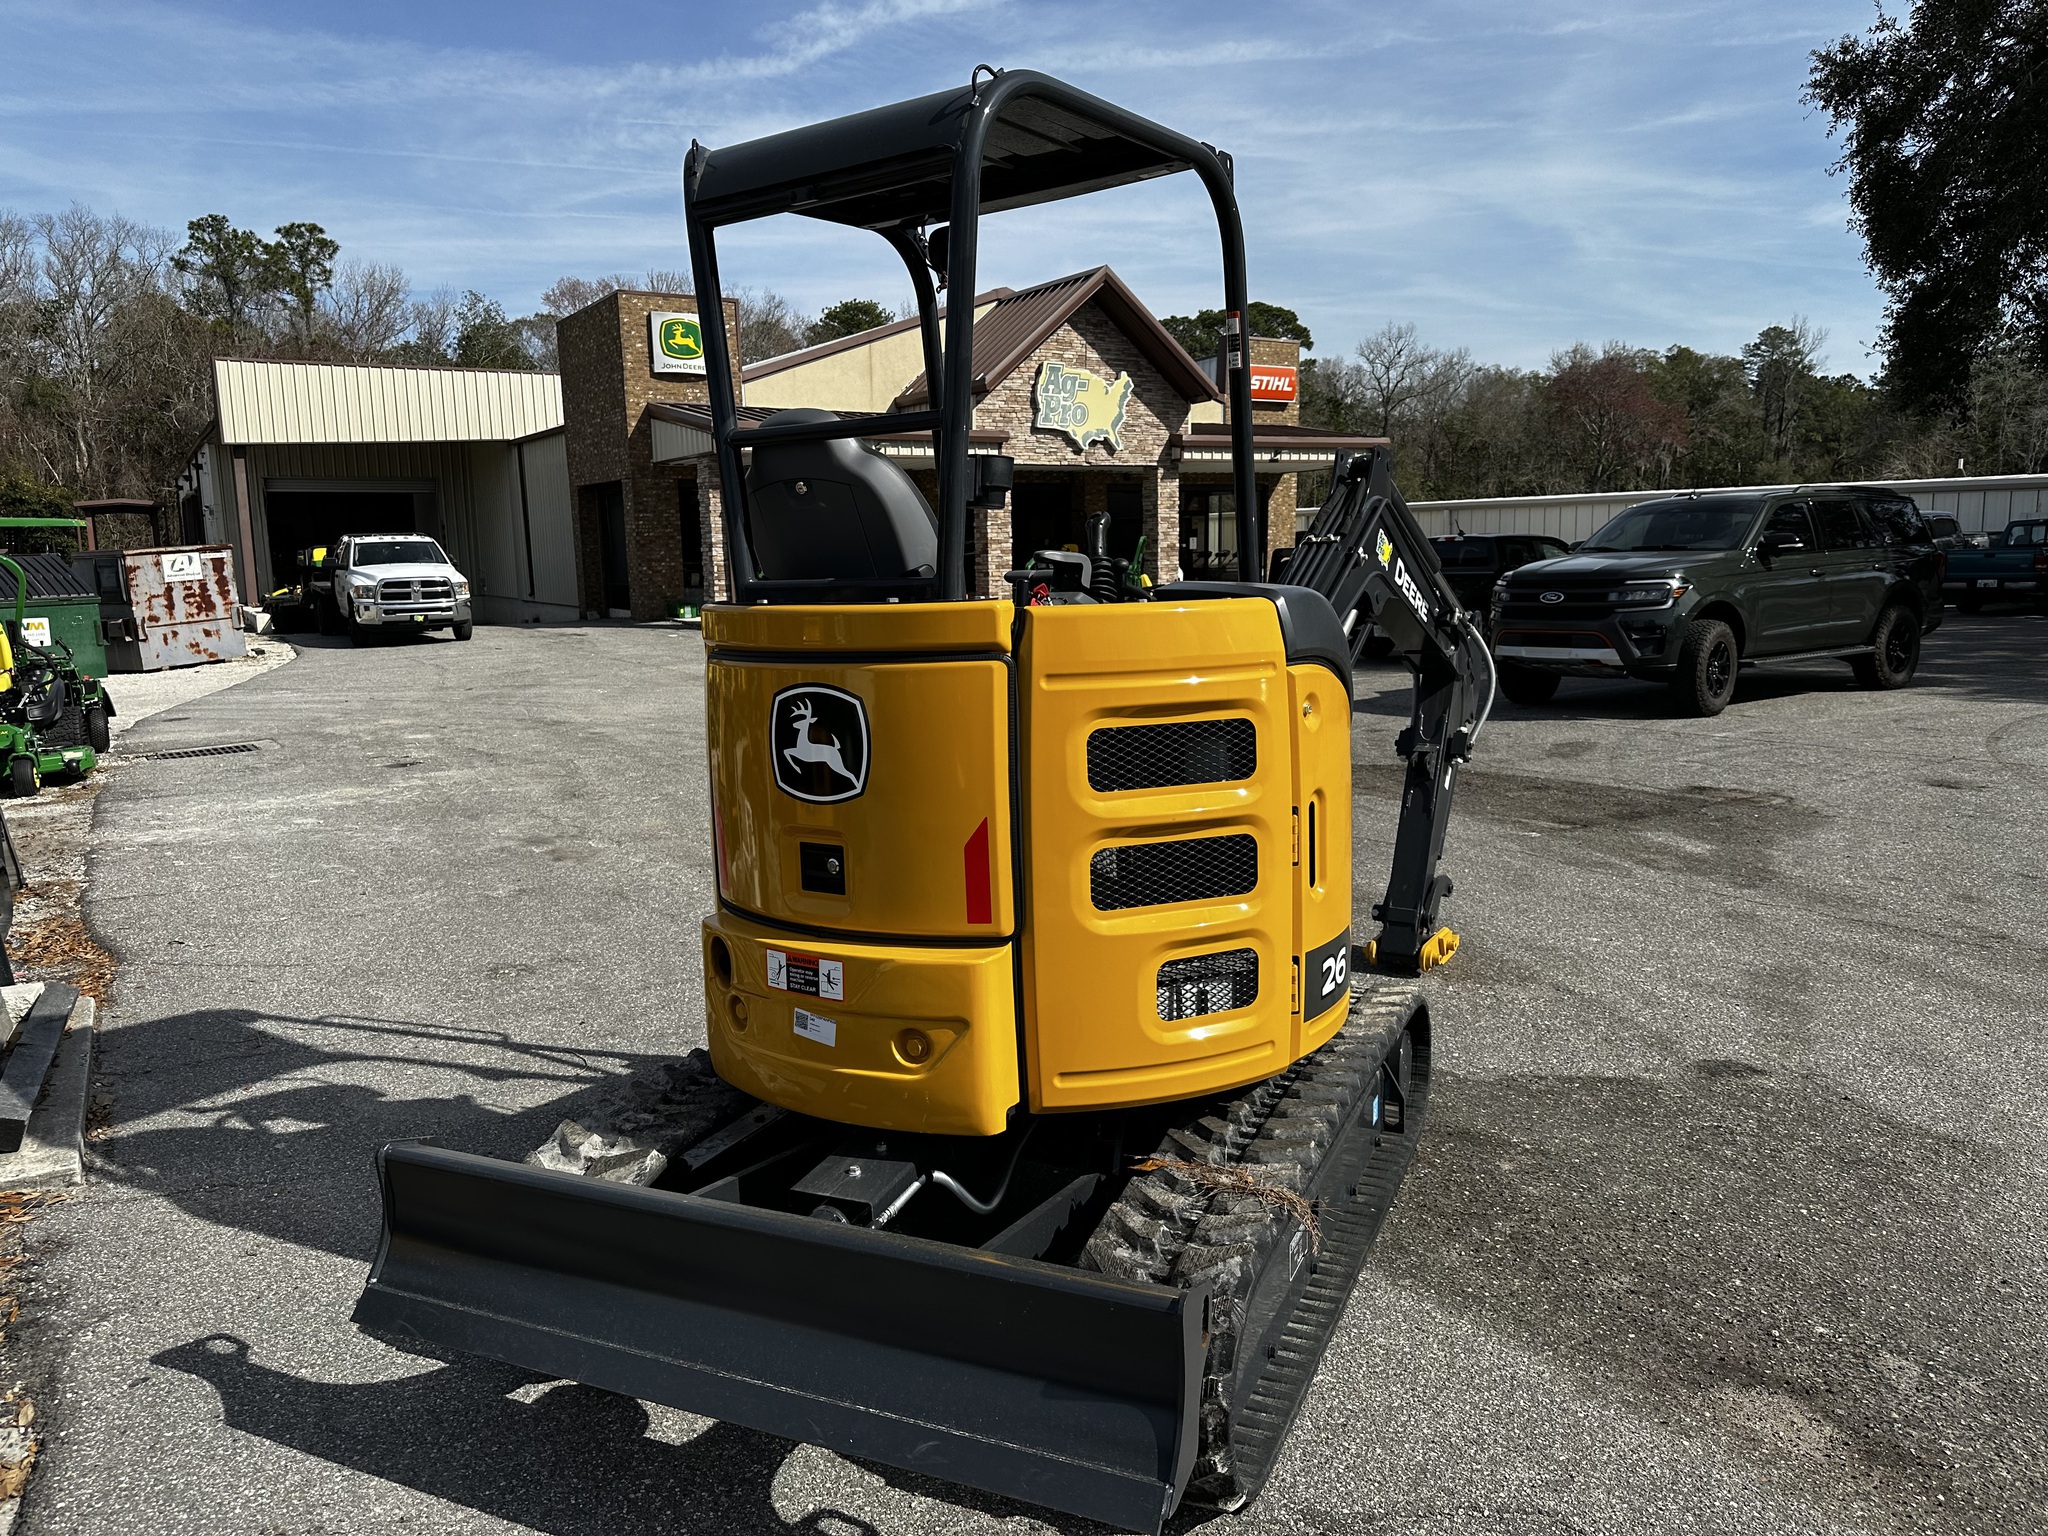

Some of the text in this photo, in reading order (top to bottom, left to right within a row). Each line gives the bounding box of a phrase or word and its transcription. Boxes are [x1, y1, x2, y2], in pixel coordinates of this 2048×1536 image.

[683, 363, 705, 371] DEERE
[1042, 364, 1088, 402] Ag-
[1251, 375, 1293, 392] STIHL
[1040, 394, 1088, 426] Pro
[1394, 556, 1429, 623] DEERE
[791, 956, 819, 966] WARNING
[1322, 946, 1346, 997] 26
[789, 982, 817, 993] STAY CLEAR
